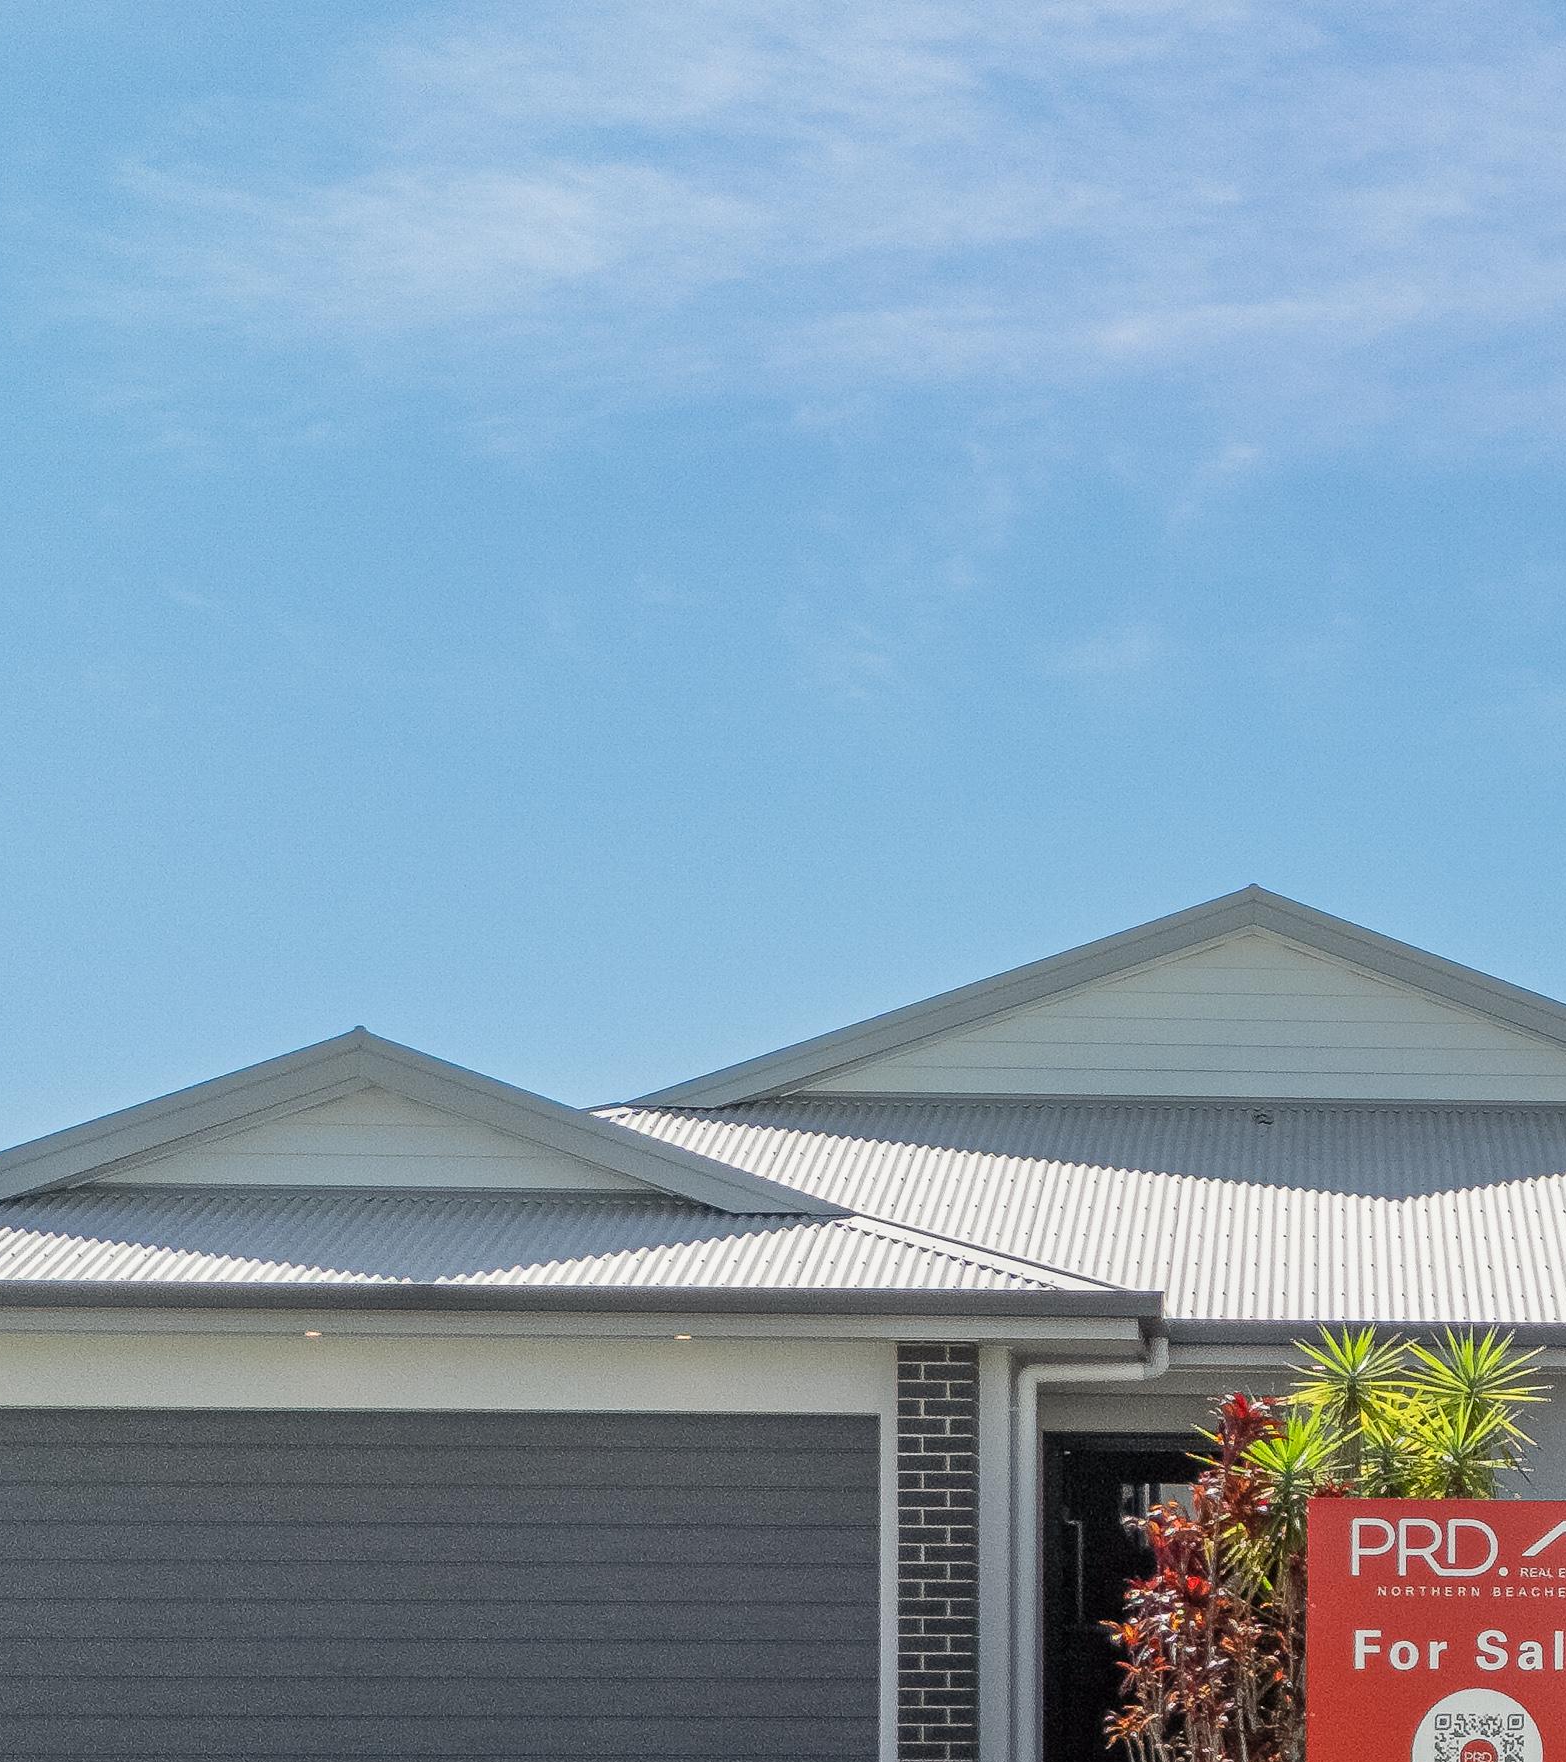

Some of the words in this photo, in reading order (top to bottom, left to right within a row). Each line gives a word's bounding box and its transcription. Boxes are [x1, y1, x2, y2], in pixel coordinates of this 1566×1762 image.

[1351, 1517, 1509, 1576] PRD.
[1520, 1567, 1554, 1578] REAL
[1377, 1585, 1481, 1597] NORTHERN
[1353, 1629, 1448, 1671] For
